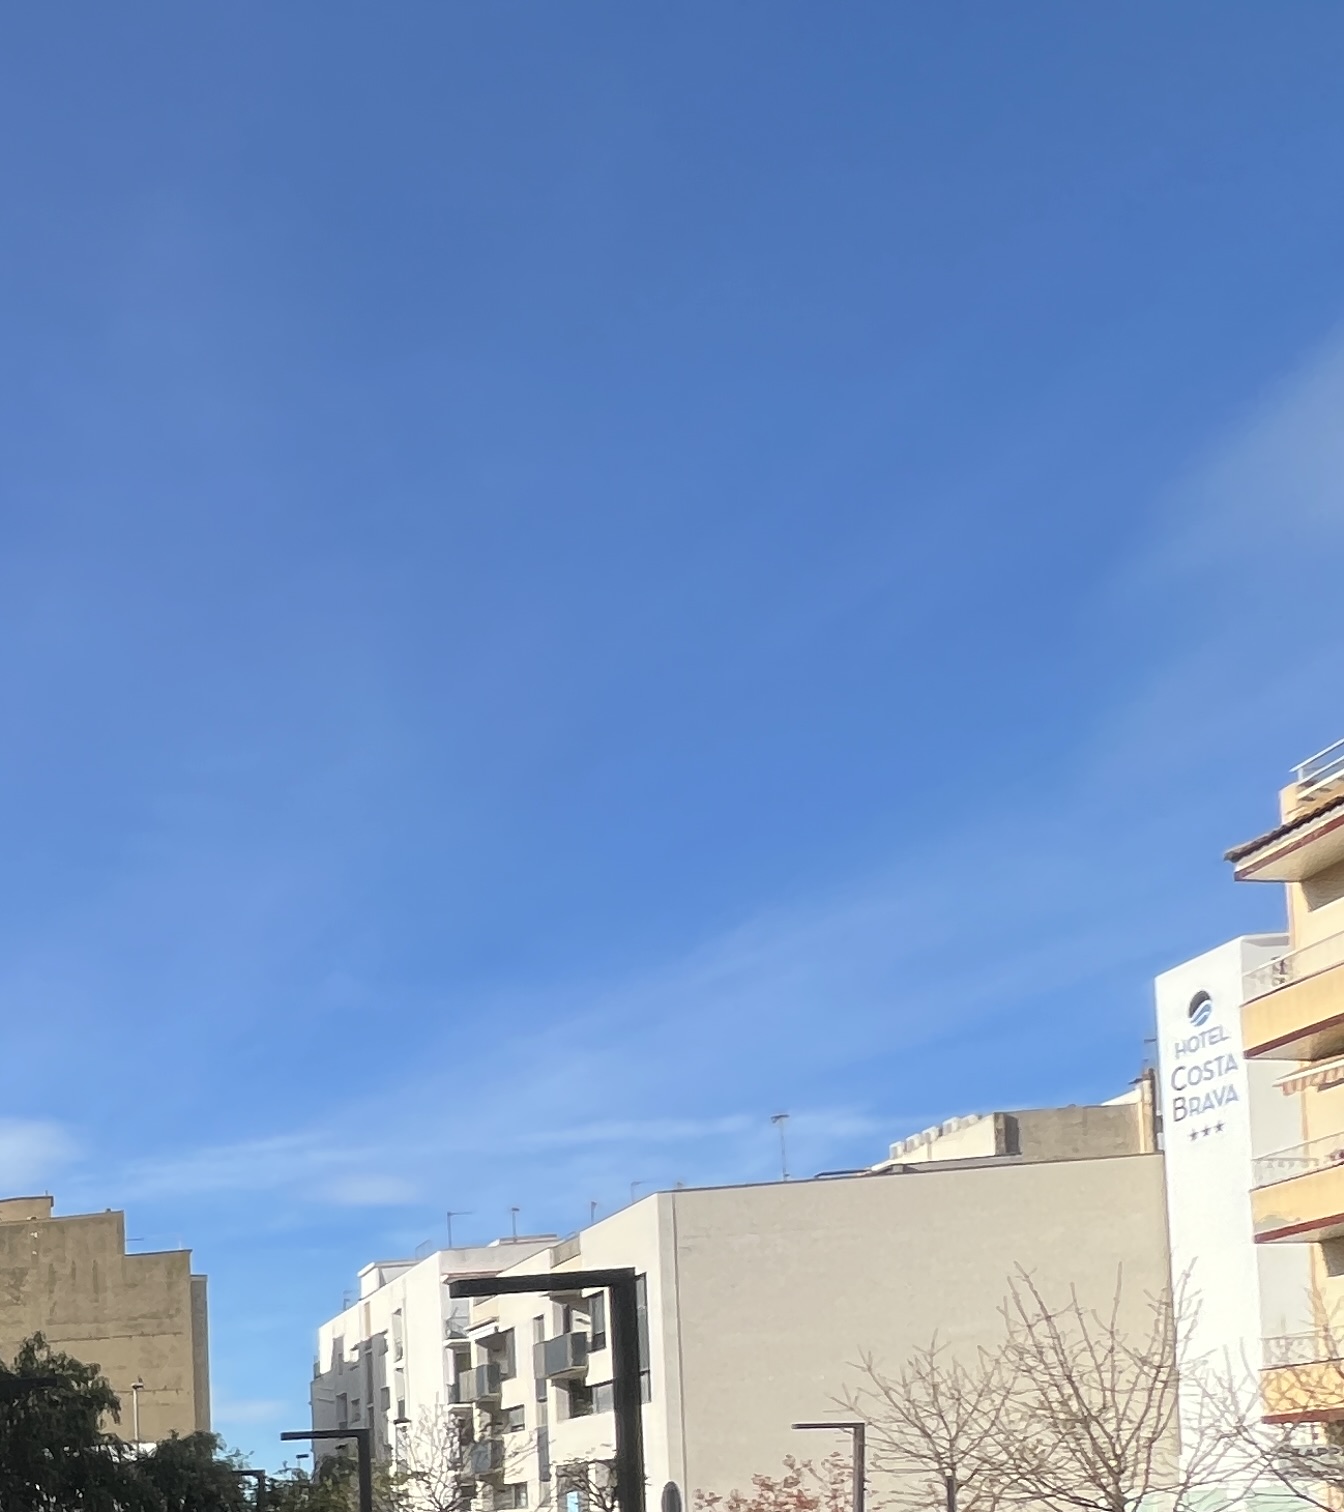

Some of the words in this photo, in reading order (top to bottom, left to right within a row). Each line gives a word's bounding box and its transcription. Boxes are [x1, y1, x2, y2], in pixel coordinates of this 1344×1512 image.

[1174, 1025, 1231, 1059] HOTEL
[1171, 1053, 1239, 1092] COSTA
[1173, 1083, 1240, 1122] BRAVA
